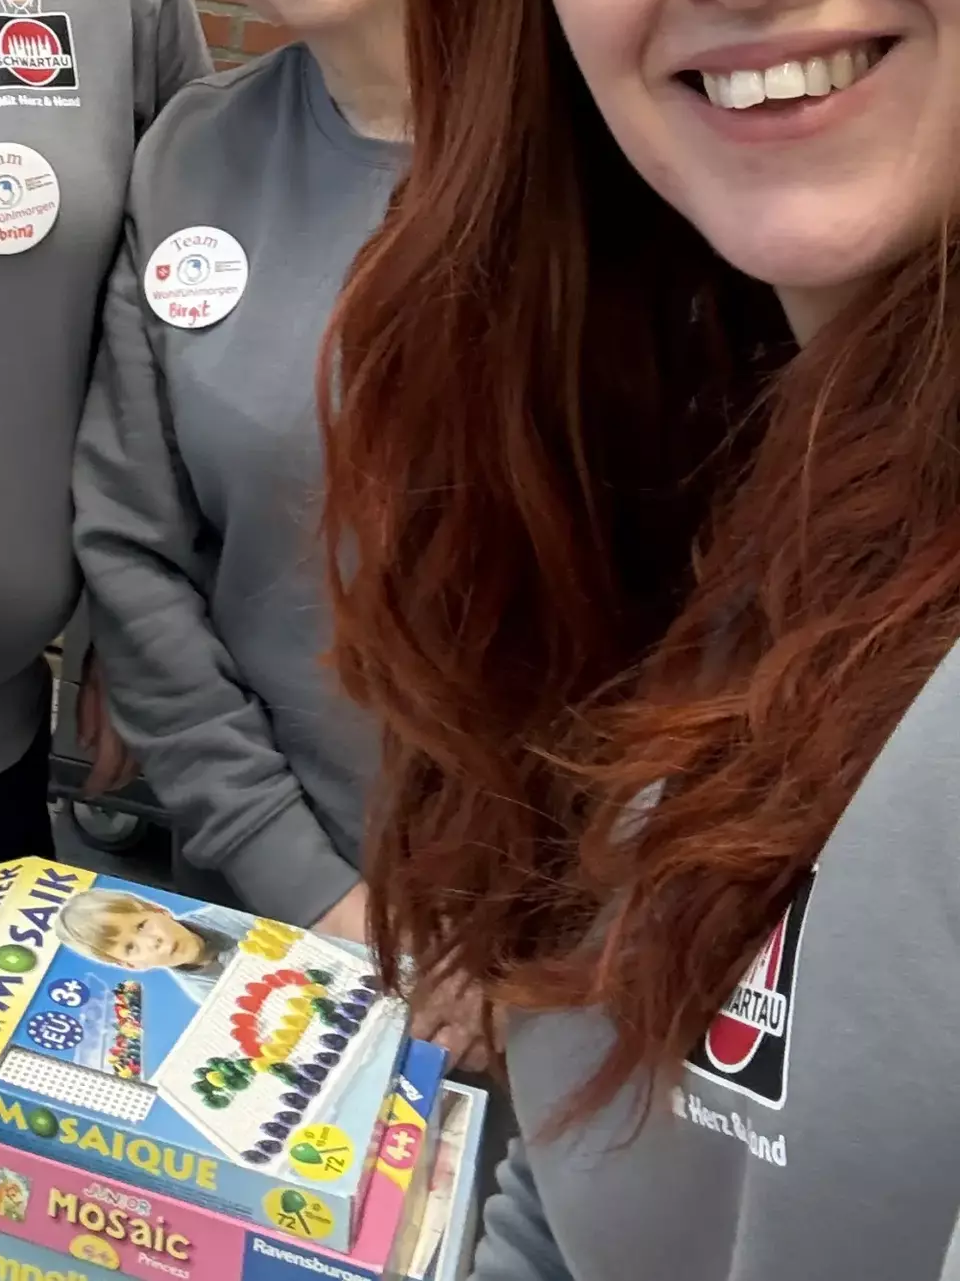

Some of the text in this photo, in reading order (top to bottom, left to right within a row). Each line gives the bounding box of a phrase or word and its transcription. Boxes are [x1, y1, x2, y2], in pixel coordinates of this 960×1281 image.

[170, 236, 218, 251] Team
[50, 979, 83, 1007] 3+
[42, 1018, 71, 1044] EU
[688, 1094, 734, 1137] Herz
[324, 1155, 345, 1174] 72
[84, 1183, 152, 1217] JUNIOR
[277, 1212, 297, 1230] 72
[138, 1251, 190, 1279] Princess
